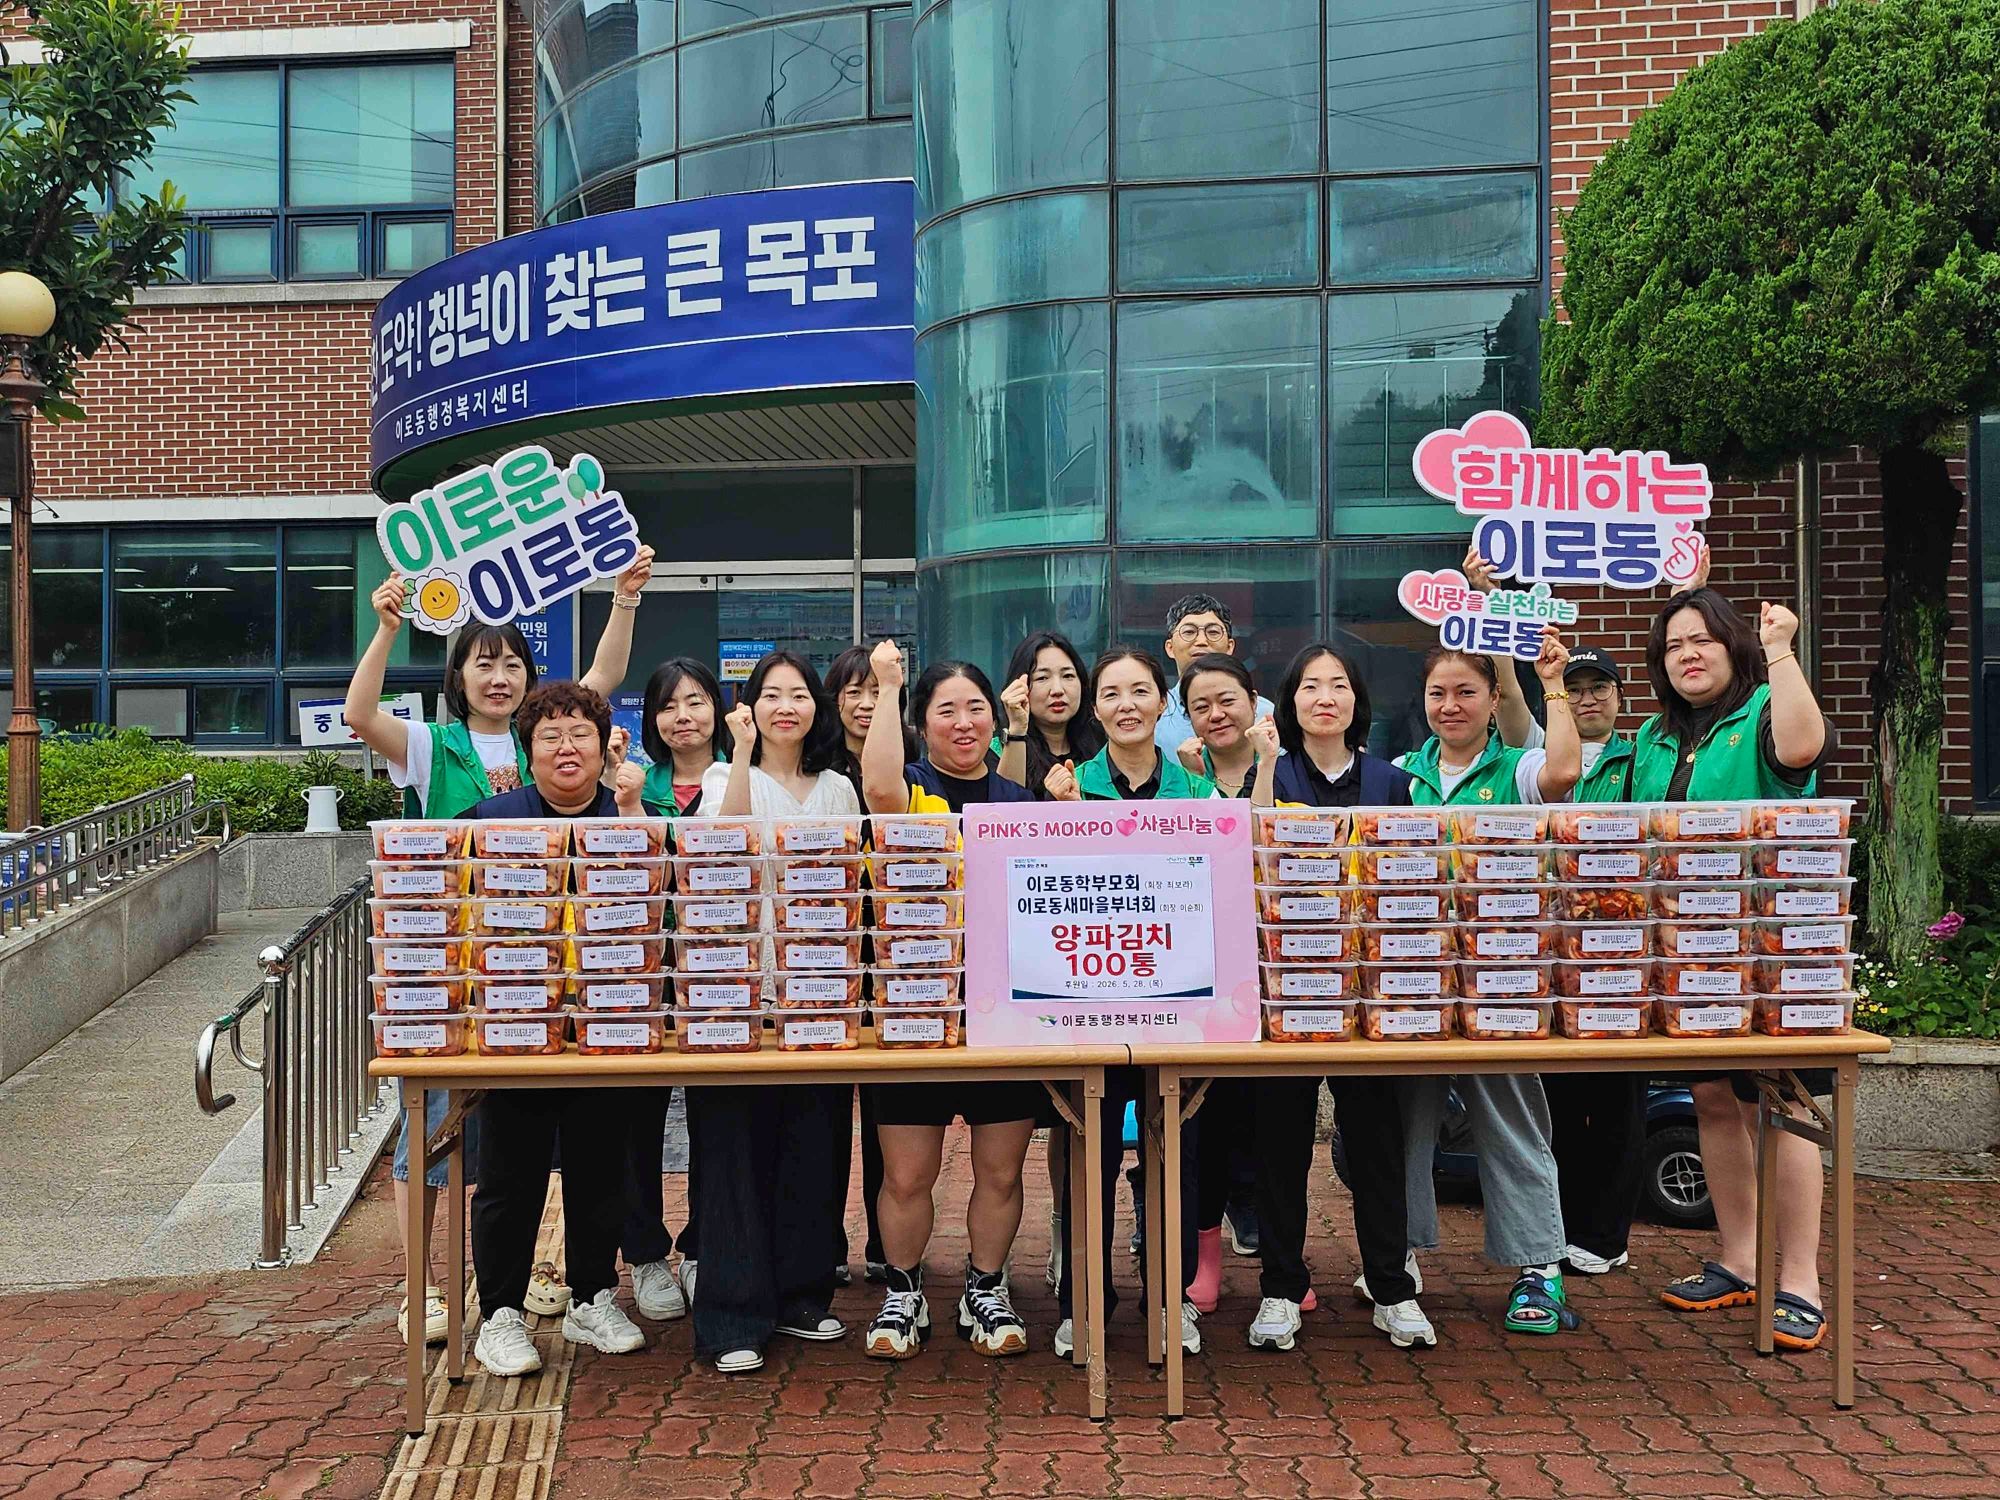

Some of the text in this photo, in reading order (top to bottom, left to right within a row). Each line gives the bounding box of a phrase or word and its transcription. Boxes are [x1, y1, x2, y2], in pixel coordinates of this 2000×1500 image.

[381, 301, 422, 394] 도약!
[428, 263, 531, 367] 청년이
[546, 245, 647, 337] 찾는
[665, 228, 724, 318] 큰
[745, 215, 879, 306] 목포
[394, 378, 530, 443] 이로동행정복지센터
[1457, 450, 1707, 515] 함께하는
[385, 451, 567, 573] 이로운
[467, 497, 638, 615] 이로동
[1479, 520, 1662, 582] 이로동
[1418, 585, 1575, 622] 사랑을 실천하는
[516, 621, 548, 638] 민원
[1444, 615, 1545, 657] 이로동
[1044, 819, 1114, 838] MOKPO
[1139, 813, 1213, 836] 사랑나눔
[1026, 874, 1140, 893] 이로동학부모회
[1017, 895, 1156, 915] 이로동새마을부녀회
[1051, 923, 1172, 952] 양파김치
[1065, 952, 1158, 978] 100통
[1097, 980, 1120, 989] 2026.
[1062, 1012, 1178, 1027] 이로동행정복지센터
